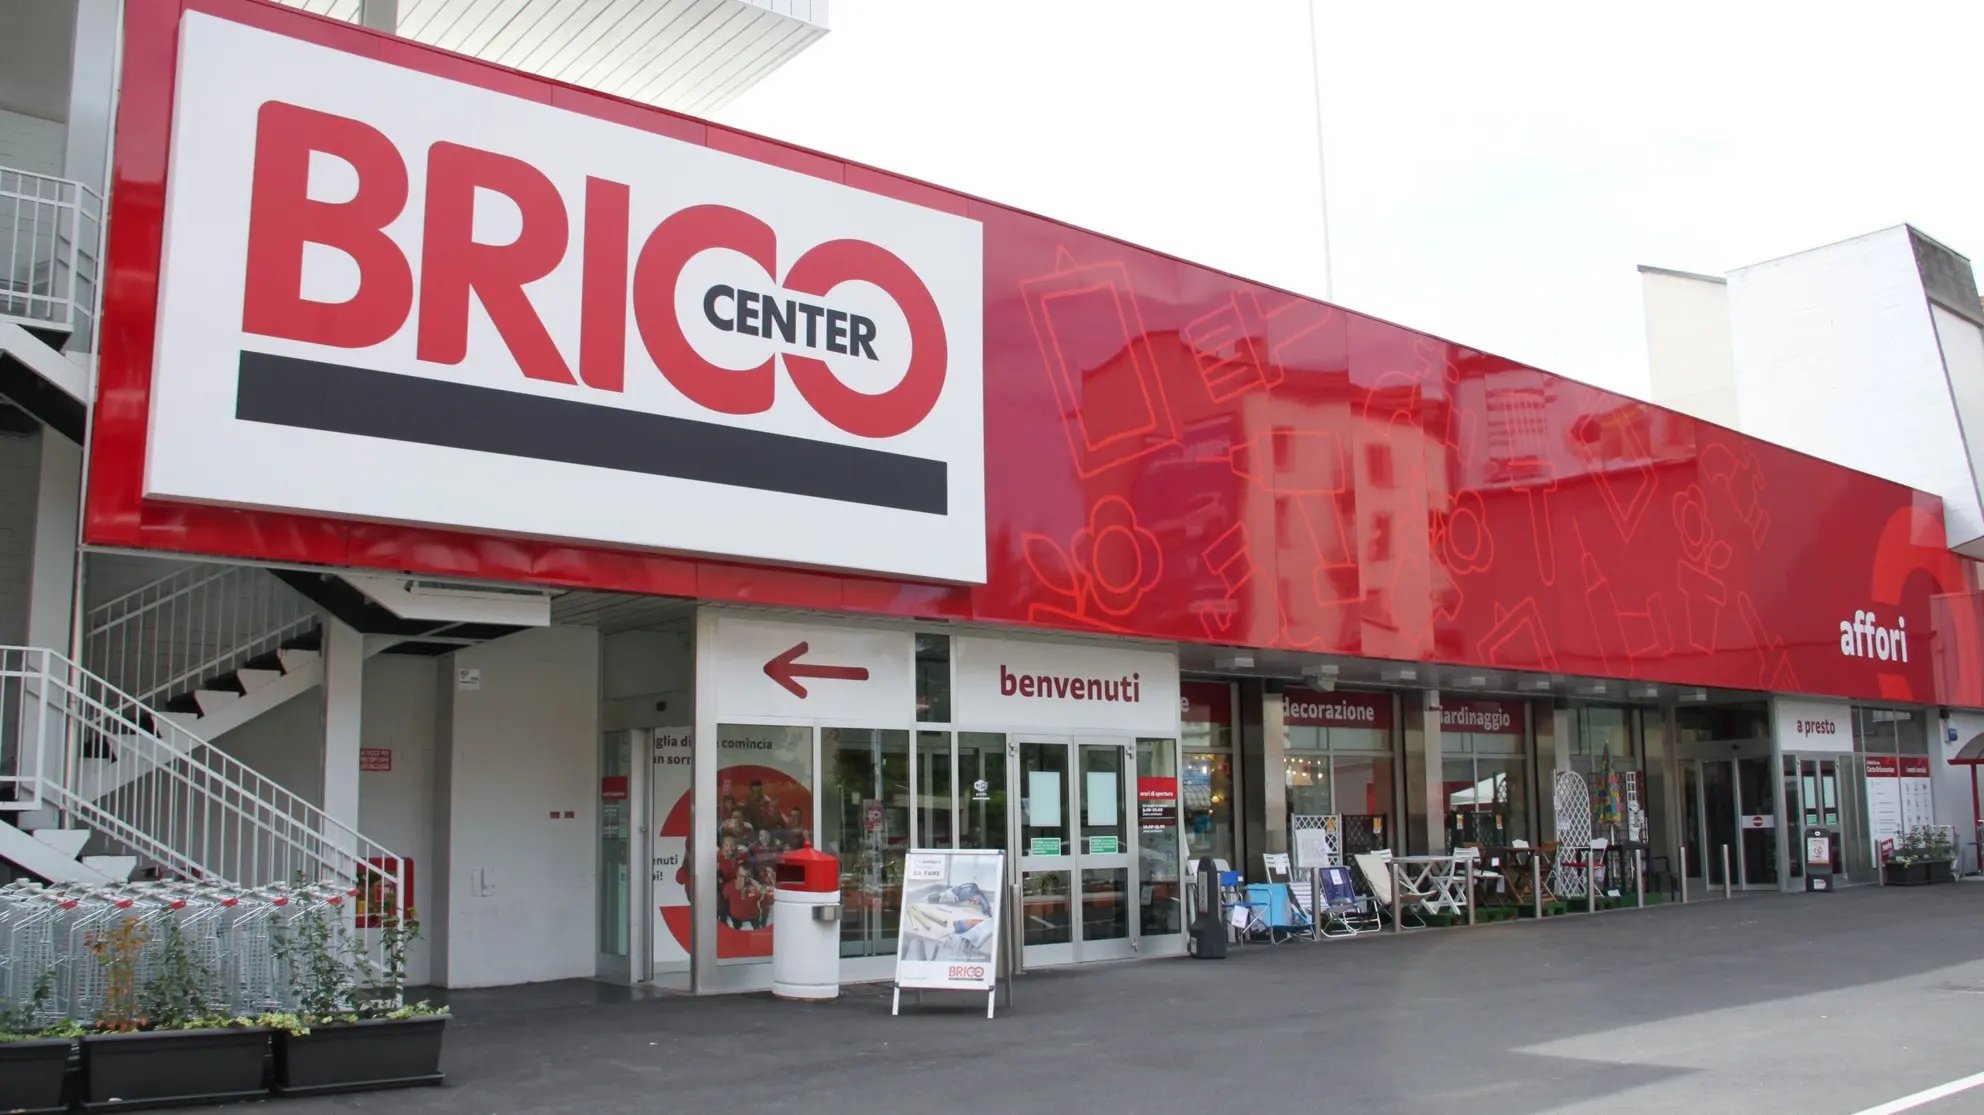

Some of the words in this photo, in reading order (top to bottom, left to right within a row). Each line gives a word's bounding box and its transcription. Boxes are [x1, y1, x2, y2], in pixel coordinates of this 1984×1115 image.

[243, 100, 947, 438] BRICO
[703, 284, 879, 361] CENTER
[1840, 609, 1908, 663] affori
[1000, 664, 1140, 702] benvenuti
[1283, 697, 1375, 721] decorazione
[1440, 704, 1510, 730] iardinaggio
[1797, 719, 1803, 733] a
[1805, 719, 1836, 738] presto
[655, 735, 677, 749] glia
[722, 738, 773, 749] comincia
[949, 966, 985, 977] BRICO
